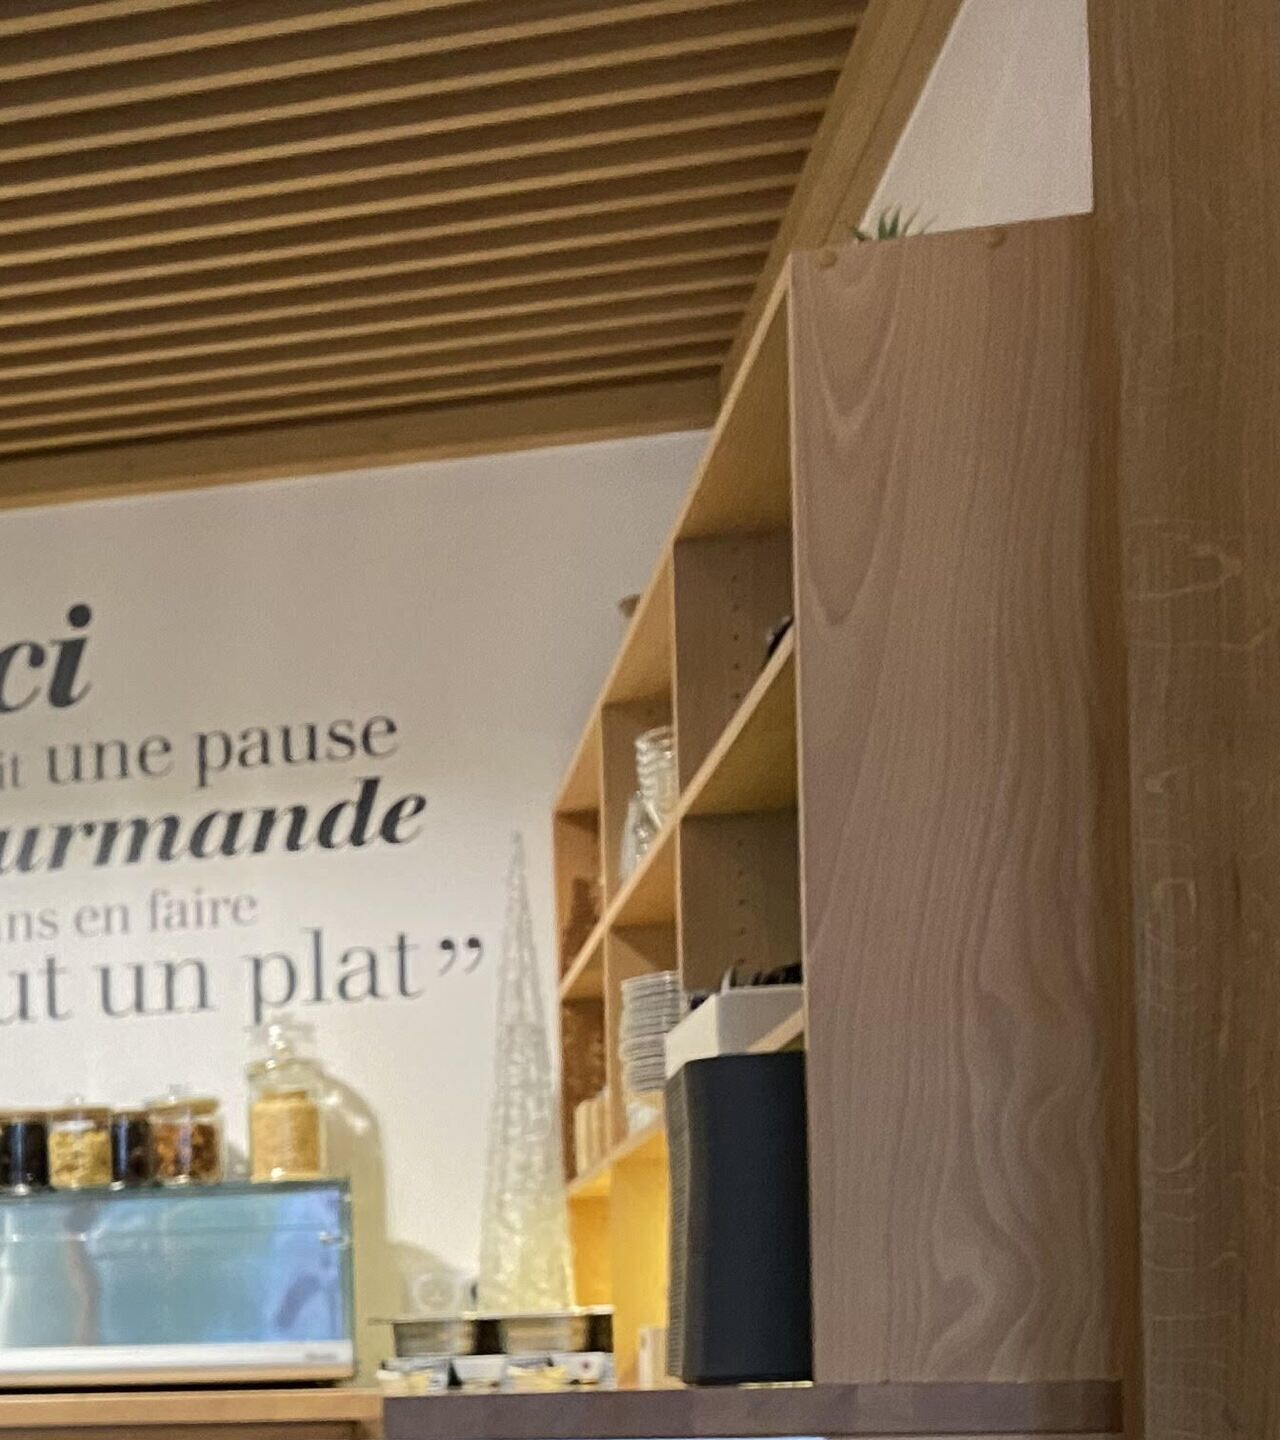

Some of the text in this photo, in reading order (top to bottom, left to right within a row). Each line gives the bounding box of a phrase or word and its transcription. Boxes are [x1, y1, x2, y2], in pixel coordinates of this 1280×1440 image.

[46, 731, 174, 783] une
[194, 714, 399, 788] pause
[74, 898, 131, 938] en
[147, 886, 259, 932] faire
[99, 952, 219, 1017] un
